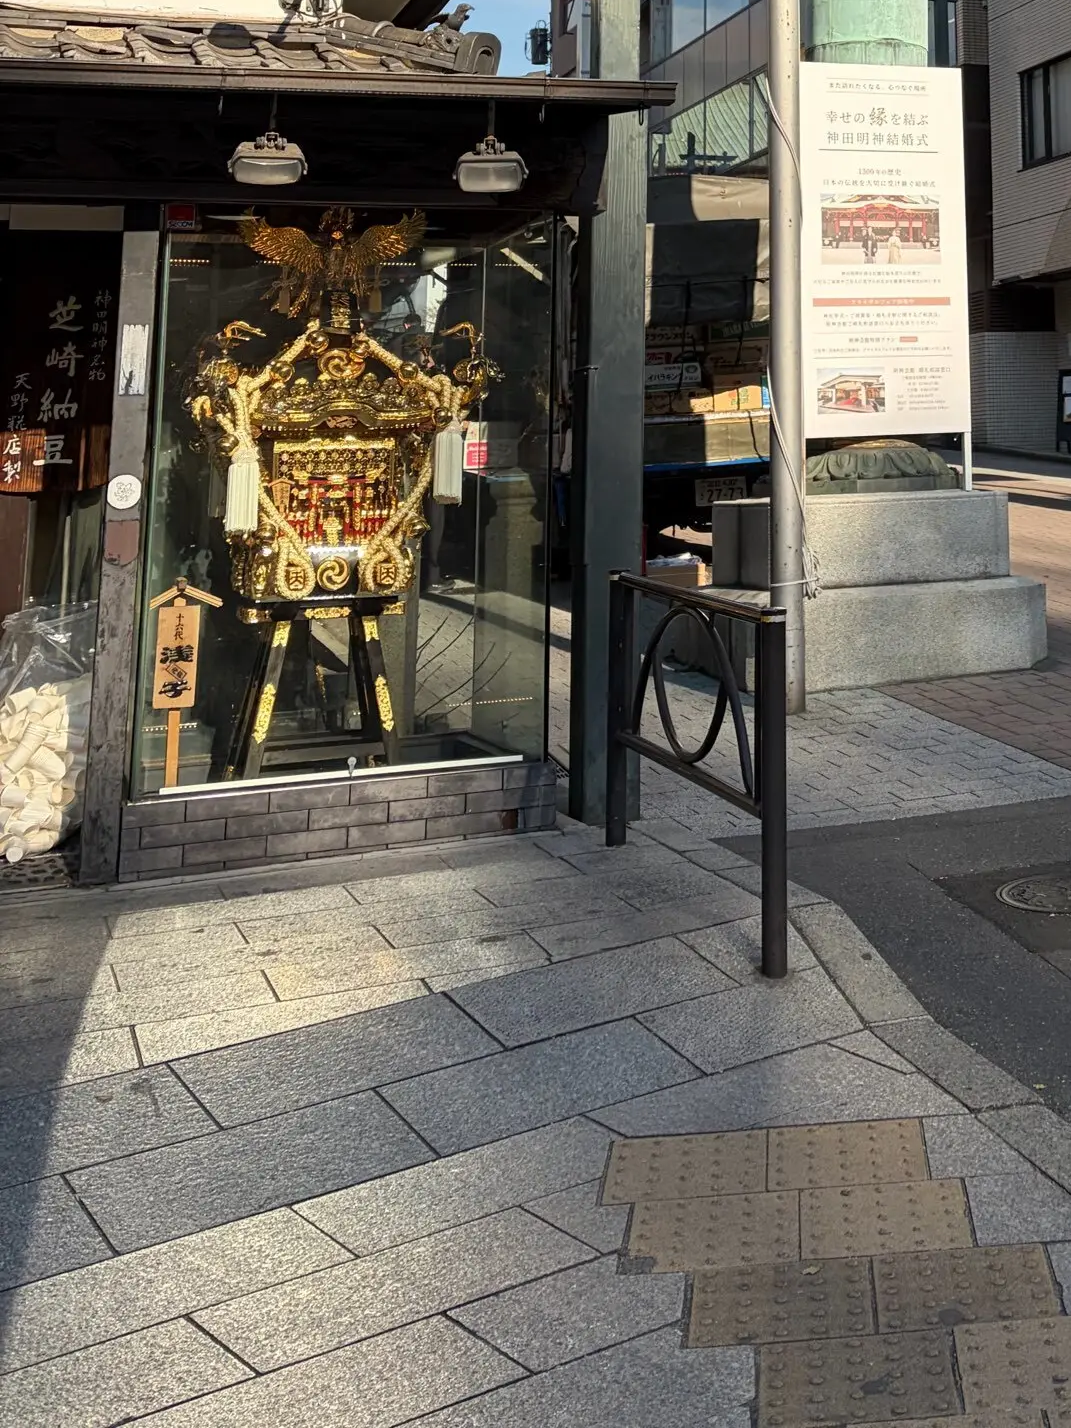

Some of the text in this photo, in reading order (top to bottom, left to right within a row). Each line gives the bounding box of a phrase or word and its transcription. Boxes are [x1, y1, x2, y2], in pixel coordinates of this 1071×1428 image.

[825, 107, 930, 127] 幸せの縁を結ぶ
[826, 131, 930, 147] 神田明神結婚式
[33, 295, 84, 466] 芝崎納豆
[174, 613, 185, 641] 十六代
